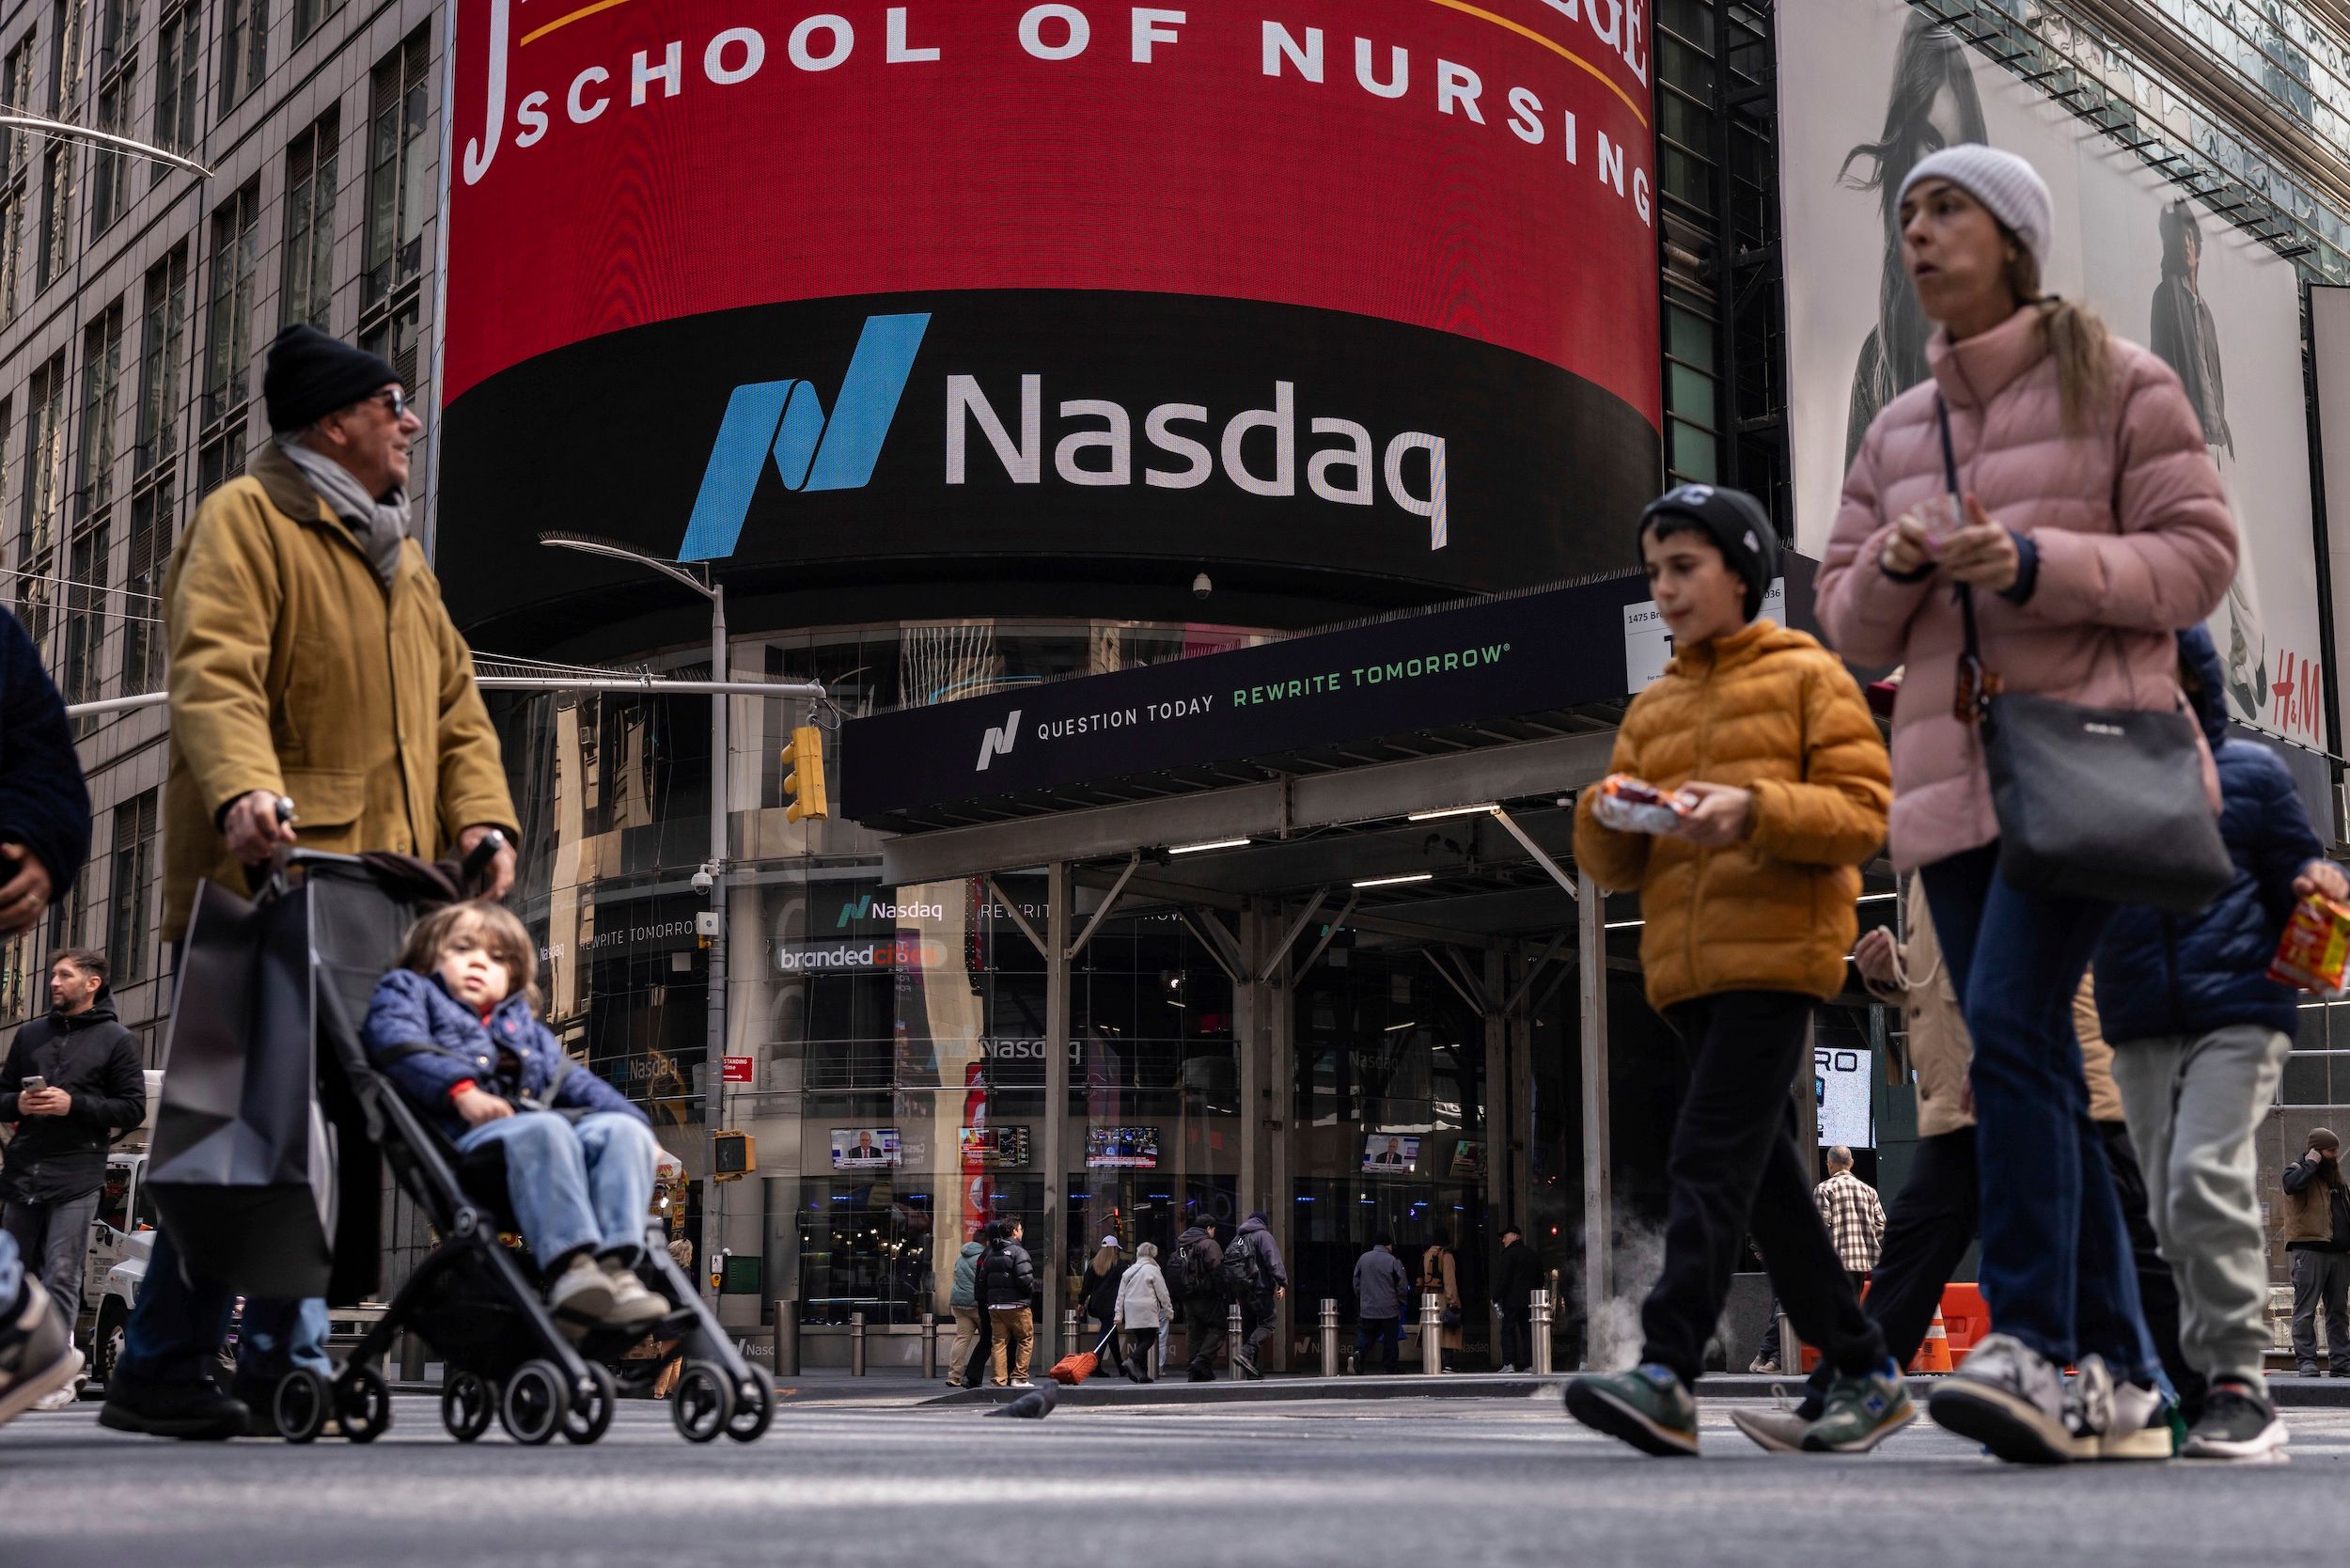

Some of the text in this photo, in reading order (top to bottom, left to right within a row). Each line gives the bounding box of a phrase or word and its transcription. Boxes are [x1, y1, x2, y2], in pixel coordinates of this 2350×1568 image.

[1537, 0, 1647, 88] GE
[515, 3, 1651, 227] SCHOOL OF NURSING
[946, 373, 1448, 551] Nasdaq
[1762, 588, 1781, 600] 036
[1628, 612, 1649, 624] 1475
[1037, 707, 1137, 741] QUESTION
[1147, 695, 1214, 723] TODAY
[1233, 673, 1341, 707] REWRITE
[2272, 649, 2319, 745] H&M
[872, 902, 943, 921] Nasdaq
[980, 903, 1049, 918] RERIT
[579, 920, 697, 951] REWRITE TOMORRO
[540, 942, 565, 962] Nasdaq
[980, 1039, 1081, 1065] Nasdq
[1349, 1050, 1399, 1074] Nasdaq
[630, 1057, 678, 1080] Nasdaq
[746, 1343, 776, 1356] Nasd
